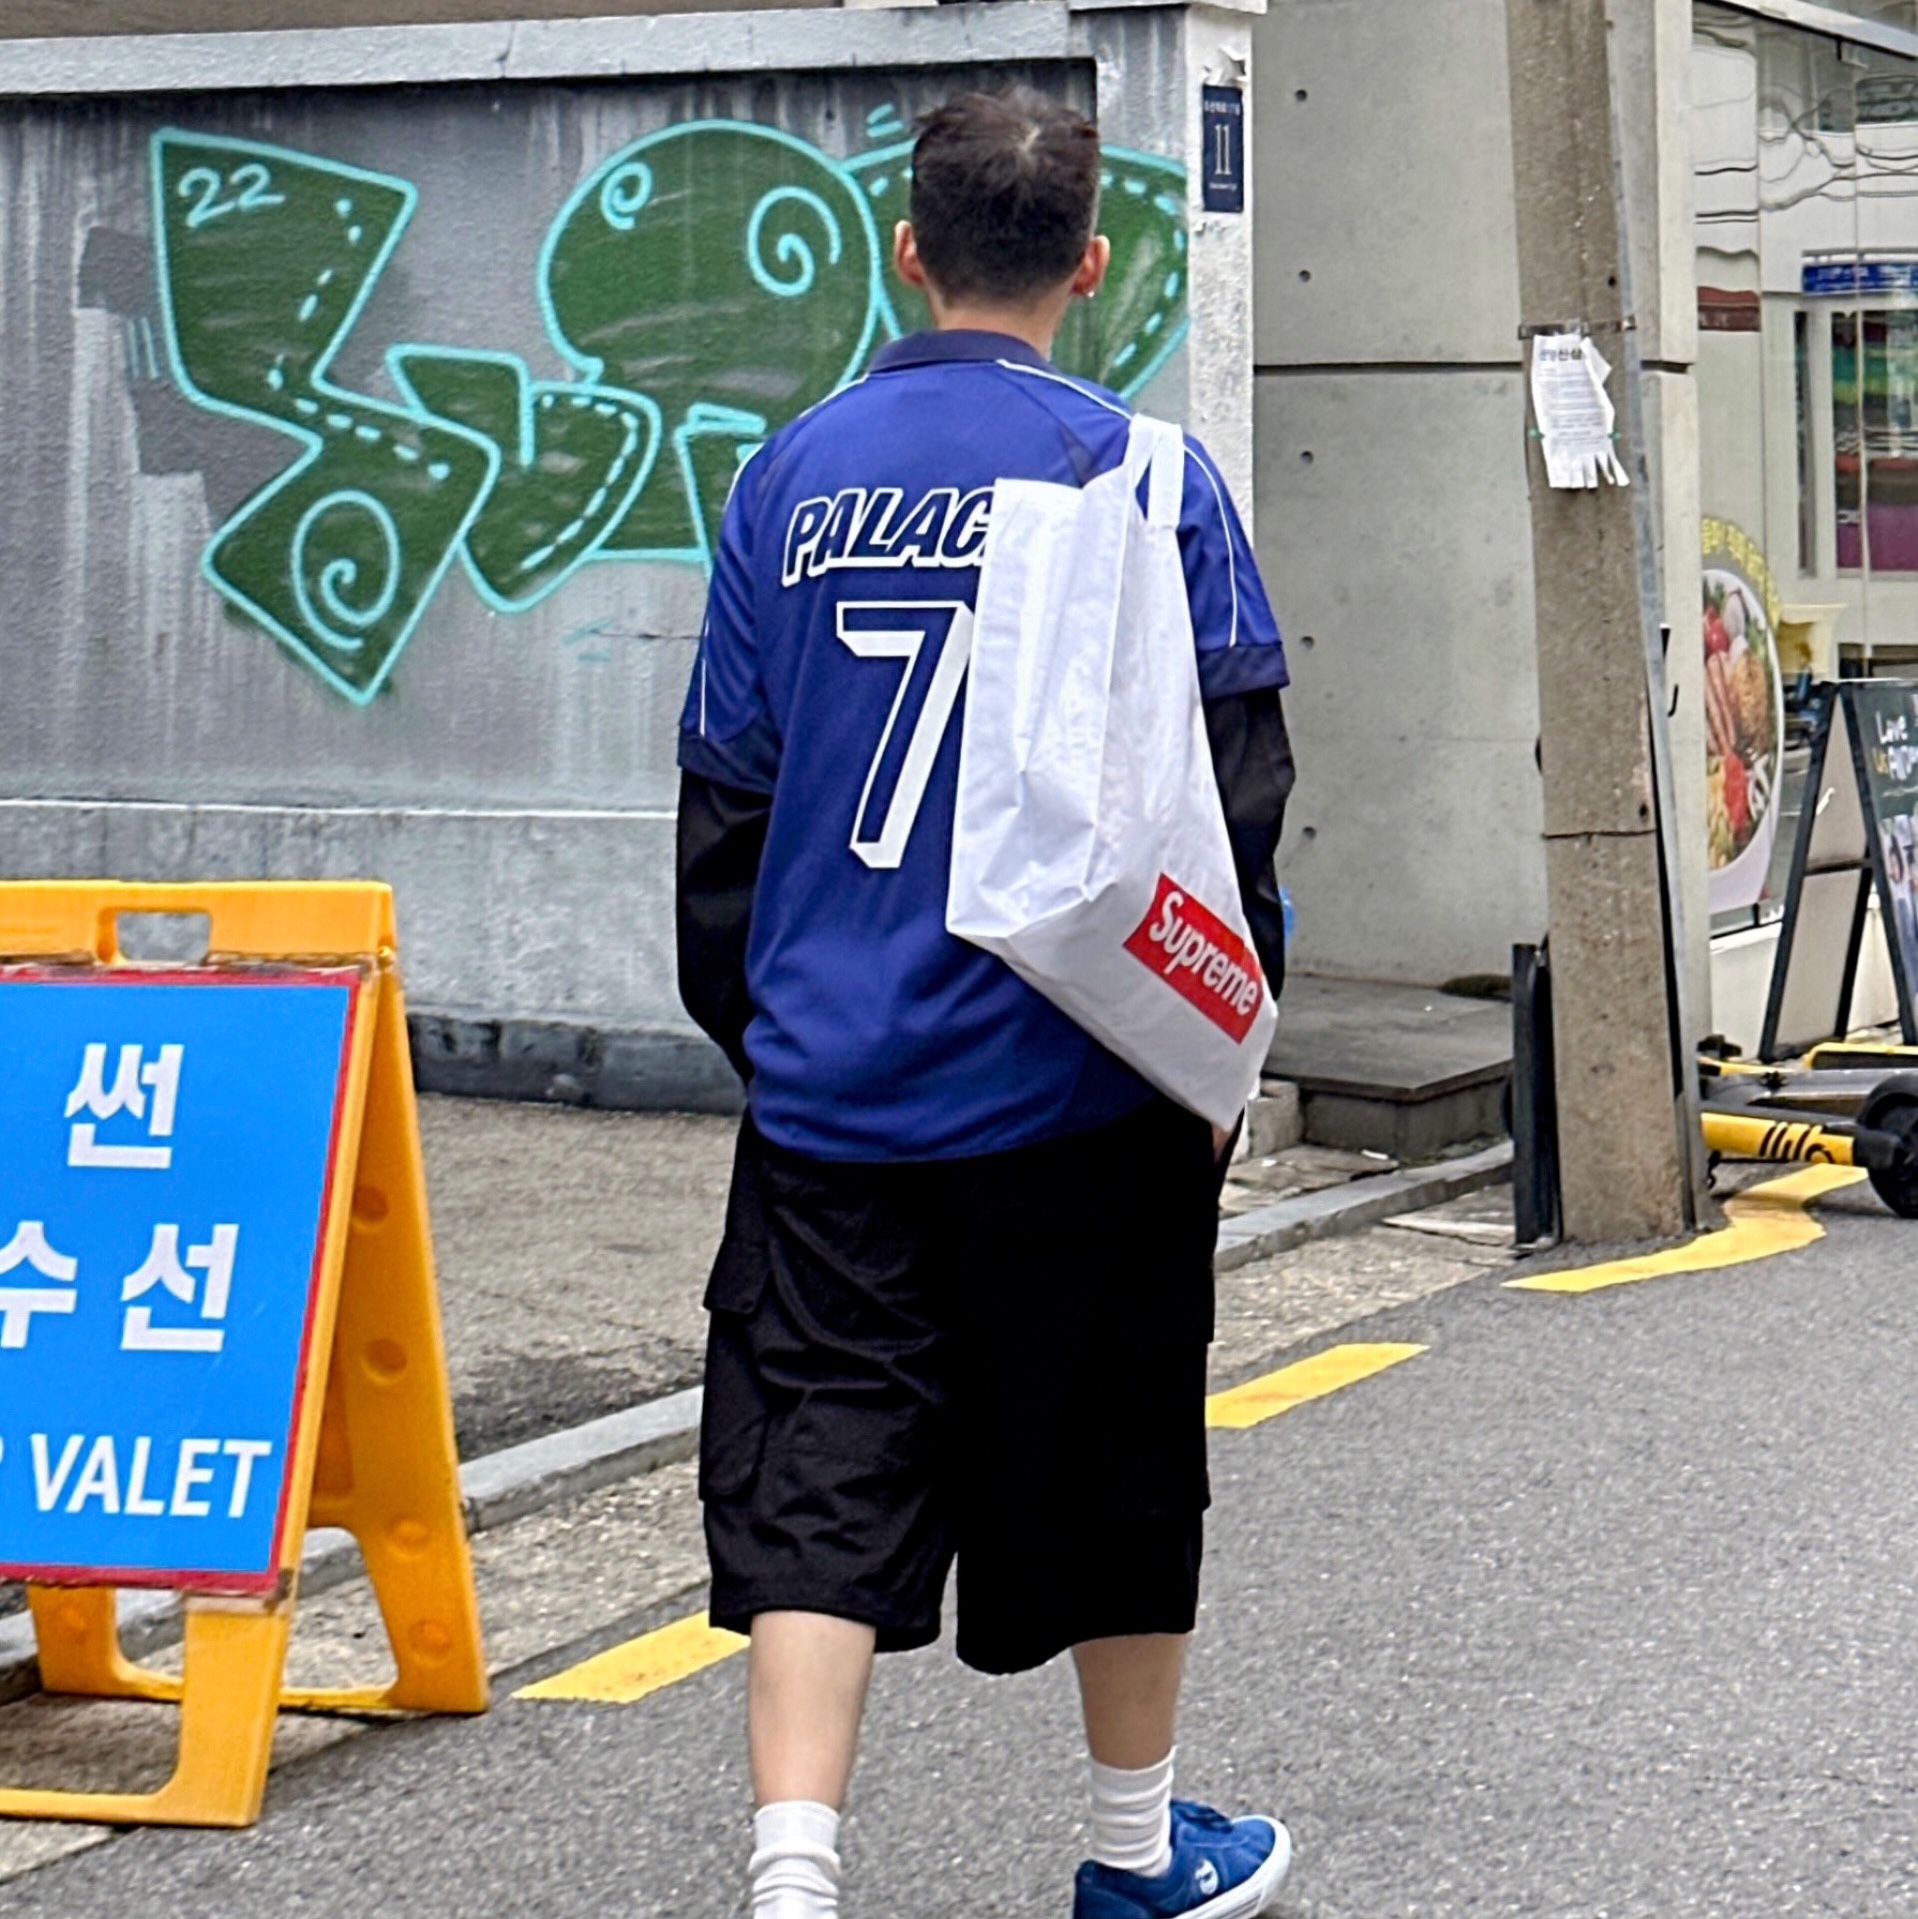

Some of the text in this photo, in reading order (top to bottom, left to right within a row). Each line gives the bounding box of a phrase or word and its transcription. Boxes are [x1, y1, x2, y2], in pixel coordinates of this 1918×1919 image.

[177, 163, 287, 230] 22
[1214, 123, 1232, 175] 11
[780, 487, 996, 587] PALAC
[835, 600, 975, 870] 7
[1149, 890, 1258, 1016] Supreme
[64, 1042, 185, 1169] 썬
[29, 1432, 273, 1519] VALET
